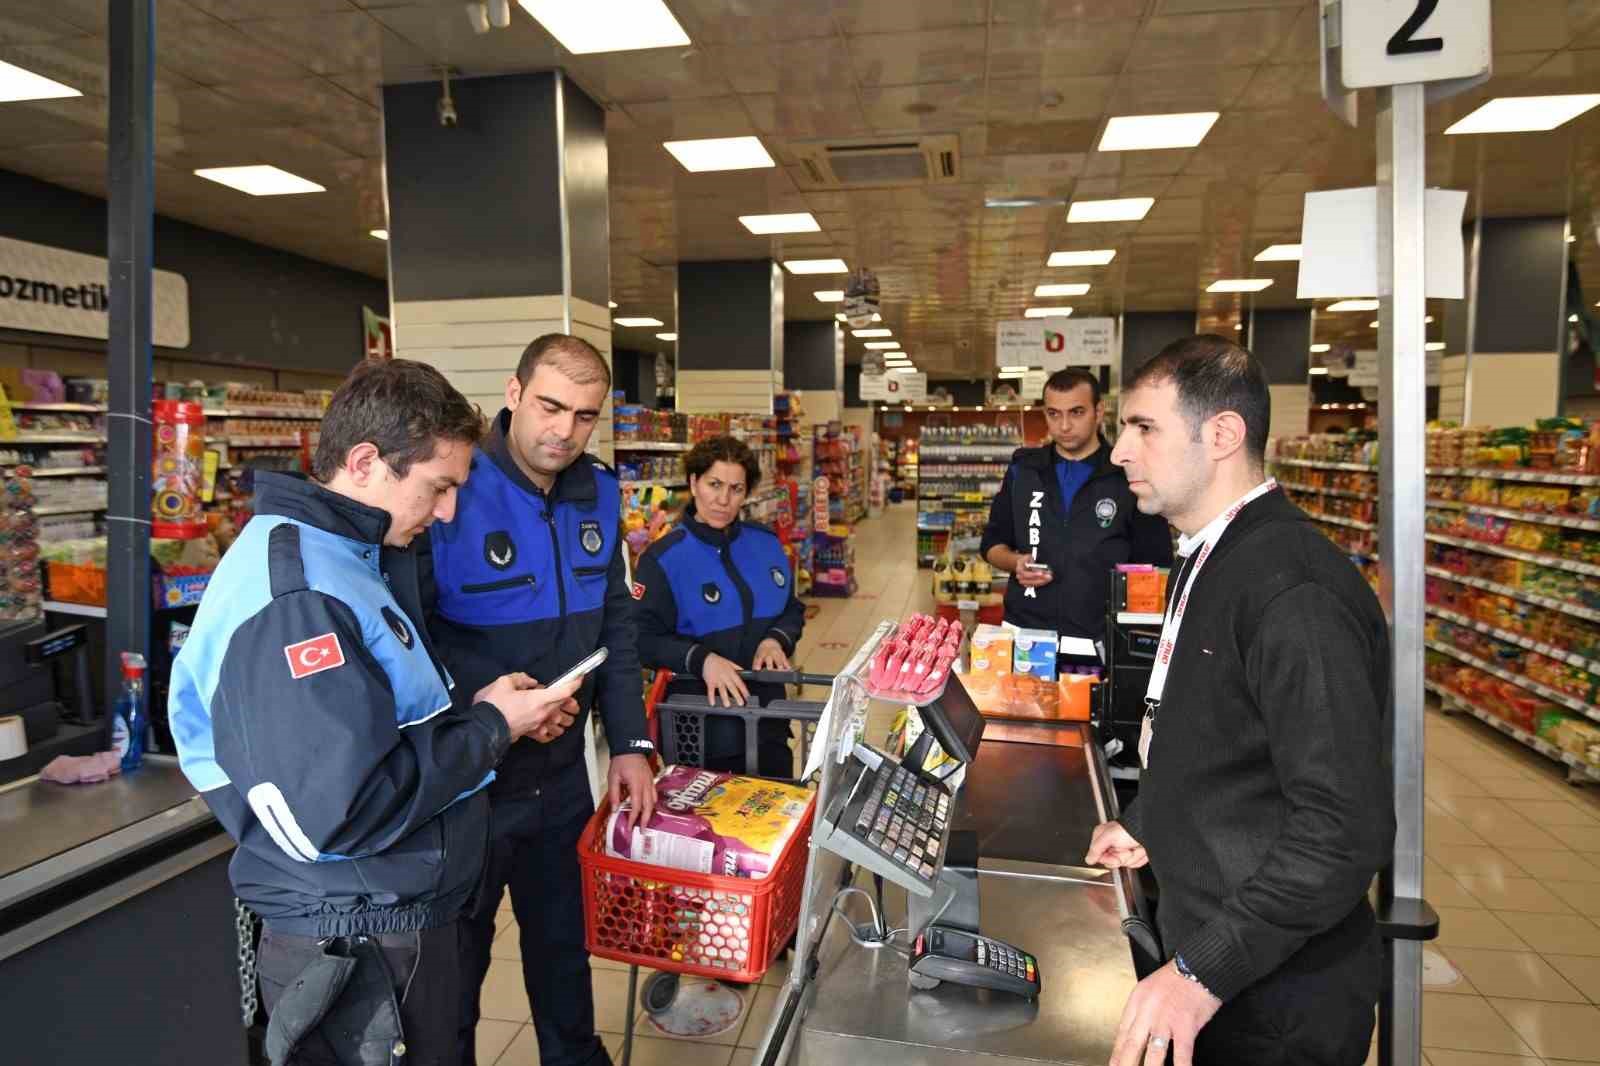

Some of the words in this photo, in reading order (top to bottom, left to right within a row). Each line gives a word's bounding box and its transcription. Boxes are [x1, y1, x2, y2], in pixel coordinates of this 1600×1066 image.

[1385, 0, 1443, 55] 2
[0, 275, 109, 312] ozmetik
[1024, 491, 1045, 598] ZABIA
